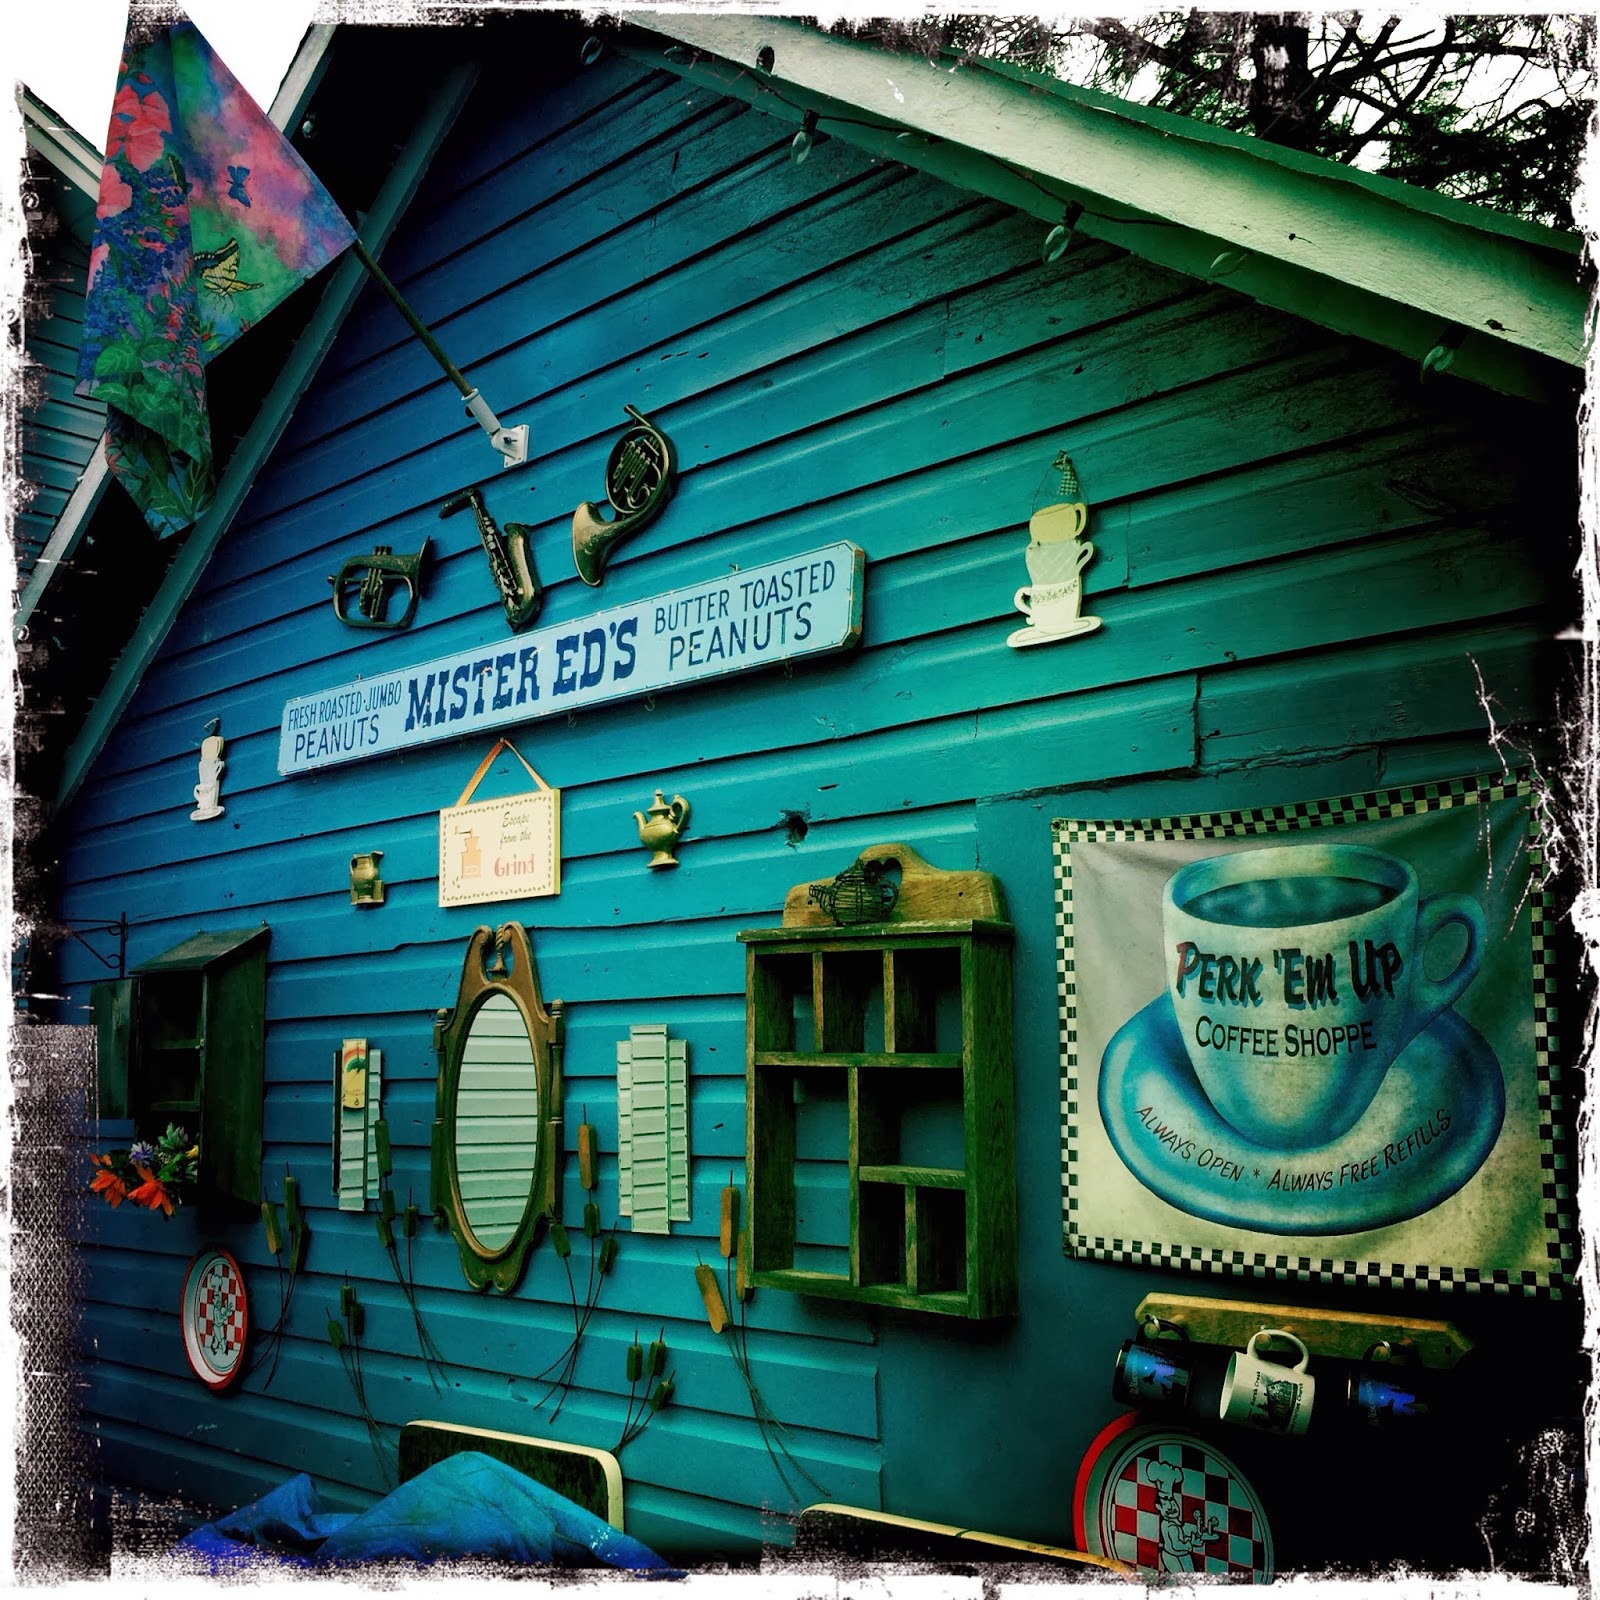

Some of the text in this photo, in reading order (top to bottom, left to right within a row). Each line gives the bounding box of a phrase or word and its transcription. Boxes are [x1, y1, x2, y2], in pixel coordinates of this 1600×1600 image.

[654, 559, 836, 635] BUTTER TOASTED
[668, 601, 812, 672] PEANUTS
[404, 616, 639, 732] MISTER ED'S
[288, 702, 317, 731] FRESH
[294, 714, 379, 762] PEANUTS
[499, 827, 532, 850] from the
[502, 811, 530, 828] Escape
[494, 853, 535, 877] Grind
[1195, 1015, 1377, 1058] COFFEE SHOPPE
[1135, 1105, 1452, 1192] ALWAYS OPEN ALWAYS FREE REFILLS
